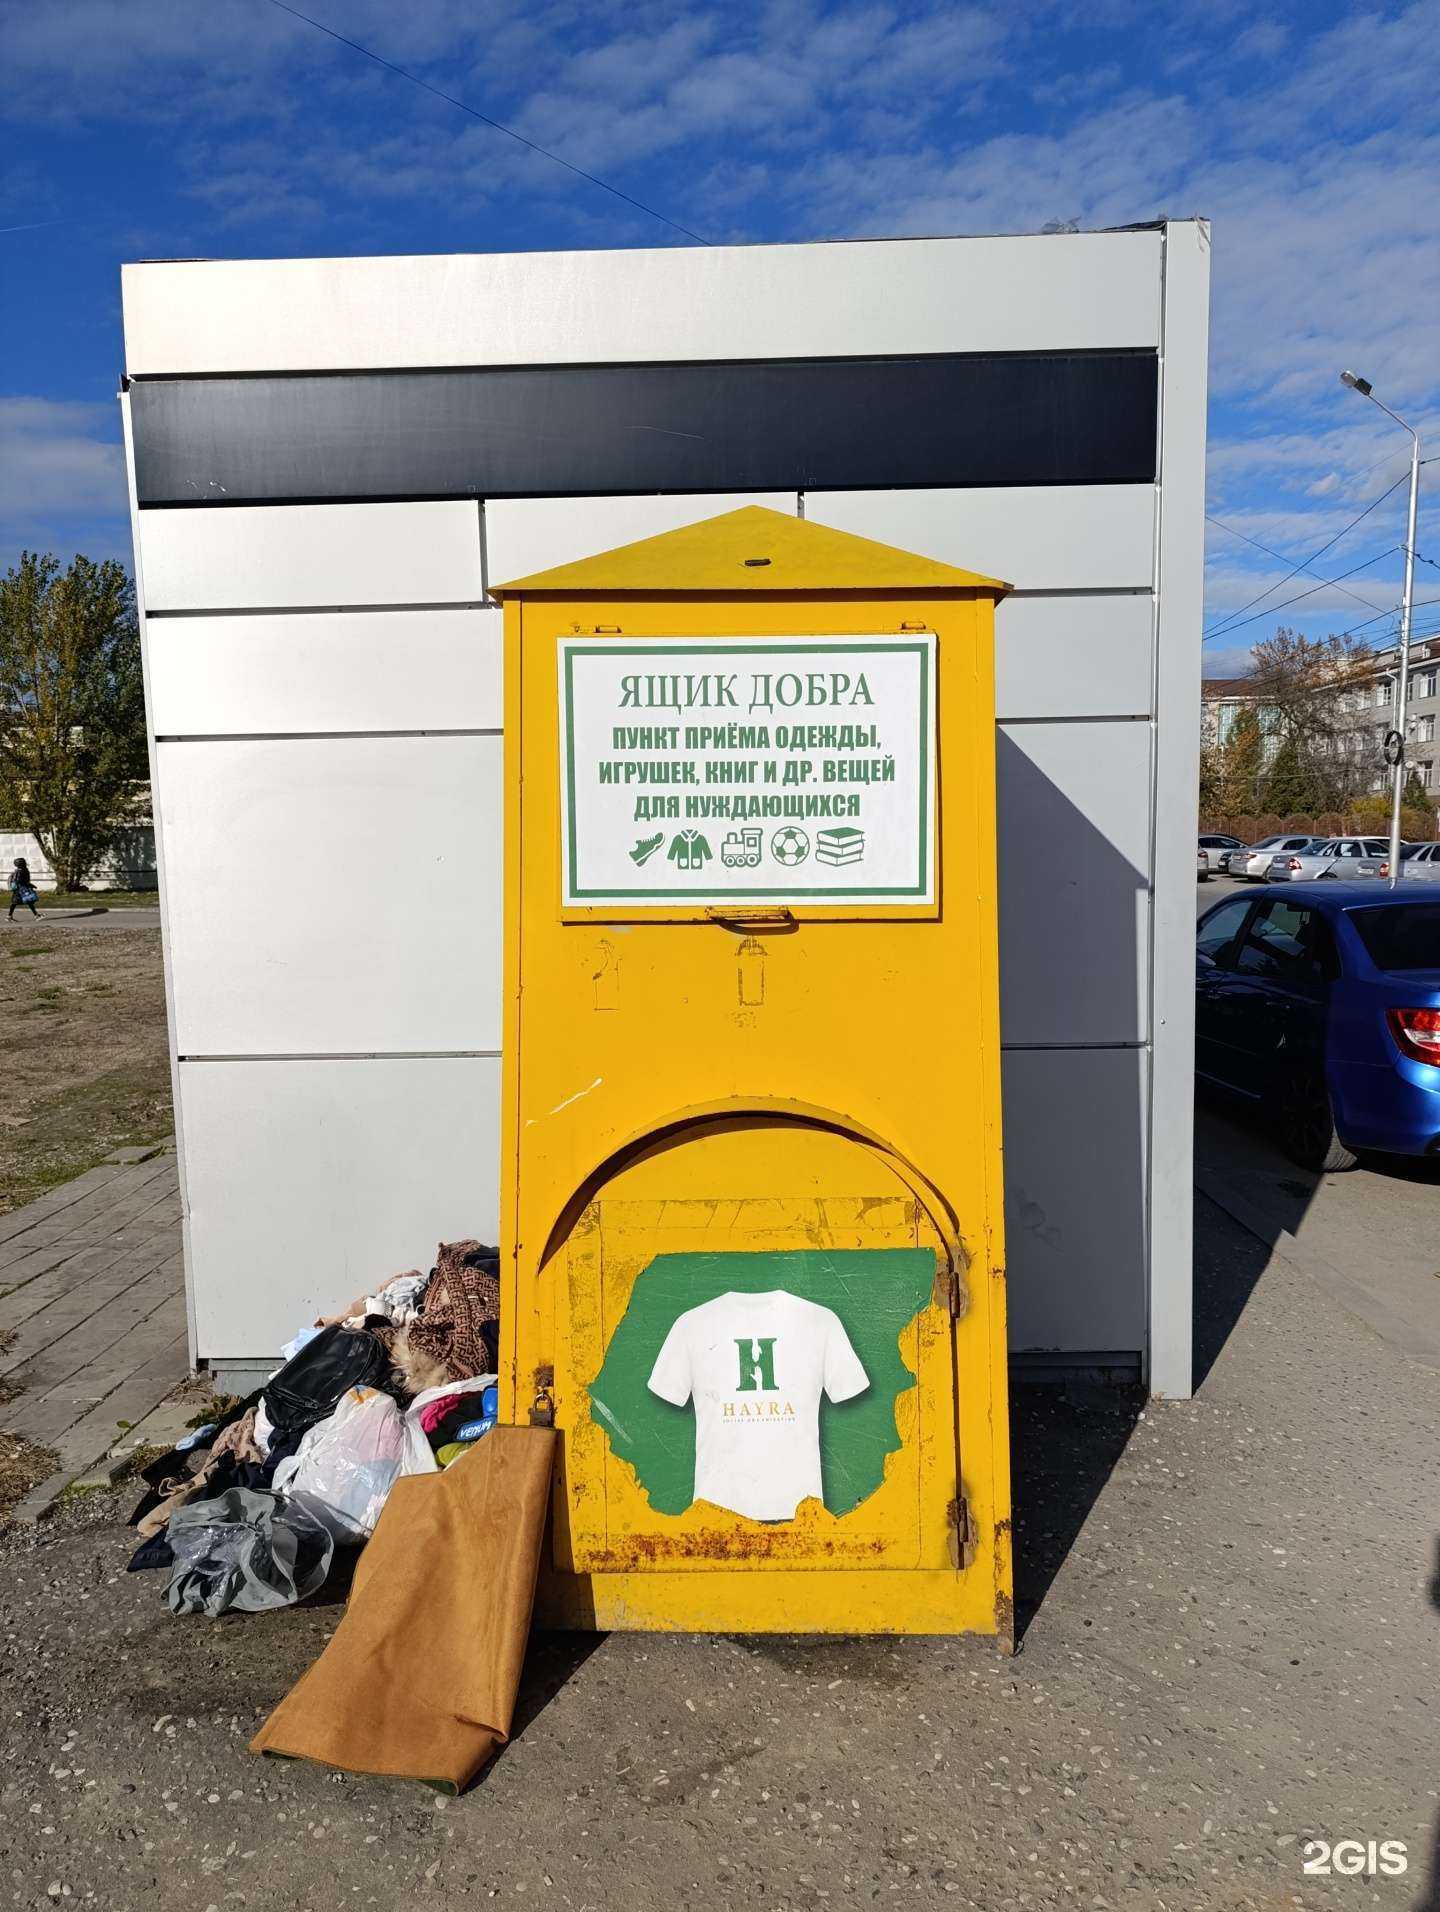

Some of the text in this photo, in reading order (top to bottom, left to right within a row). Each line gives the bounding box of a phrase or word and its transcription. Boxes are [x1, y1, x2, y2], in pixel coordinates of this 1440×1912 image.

[618, 672, 875, 715] ЯЩИК ДОБРА
[612, 722, 882, 753] ПУНКТ ПРИЁМА ОДЕЖДЫ,
[598, 754, 895, 786] ИГРУШЕК, КНИГ И ДР. ВЕЩЕЙ
[633, 794, 861, 822] ДЛЯ НУЖДАЮЩИХСЯ
[723, 1401, 796, 1417] HAYRA
[459, 1421, 492, 1438] VENUM
